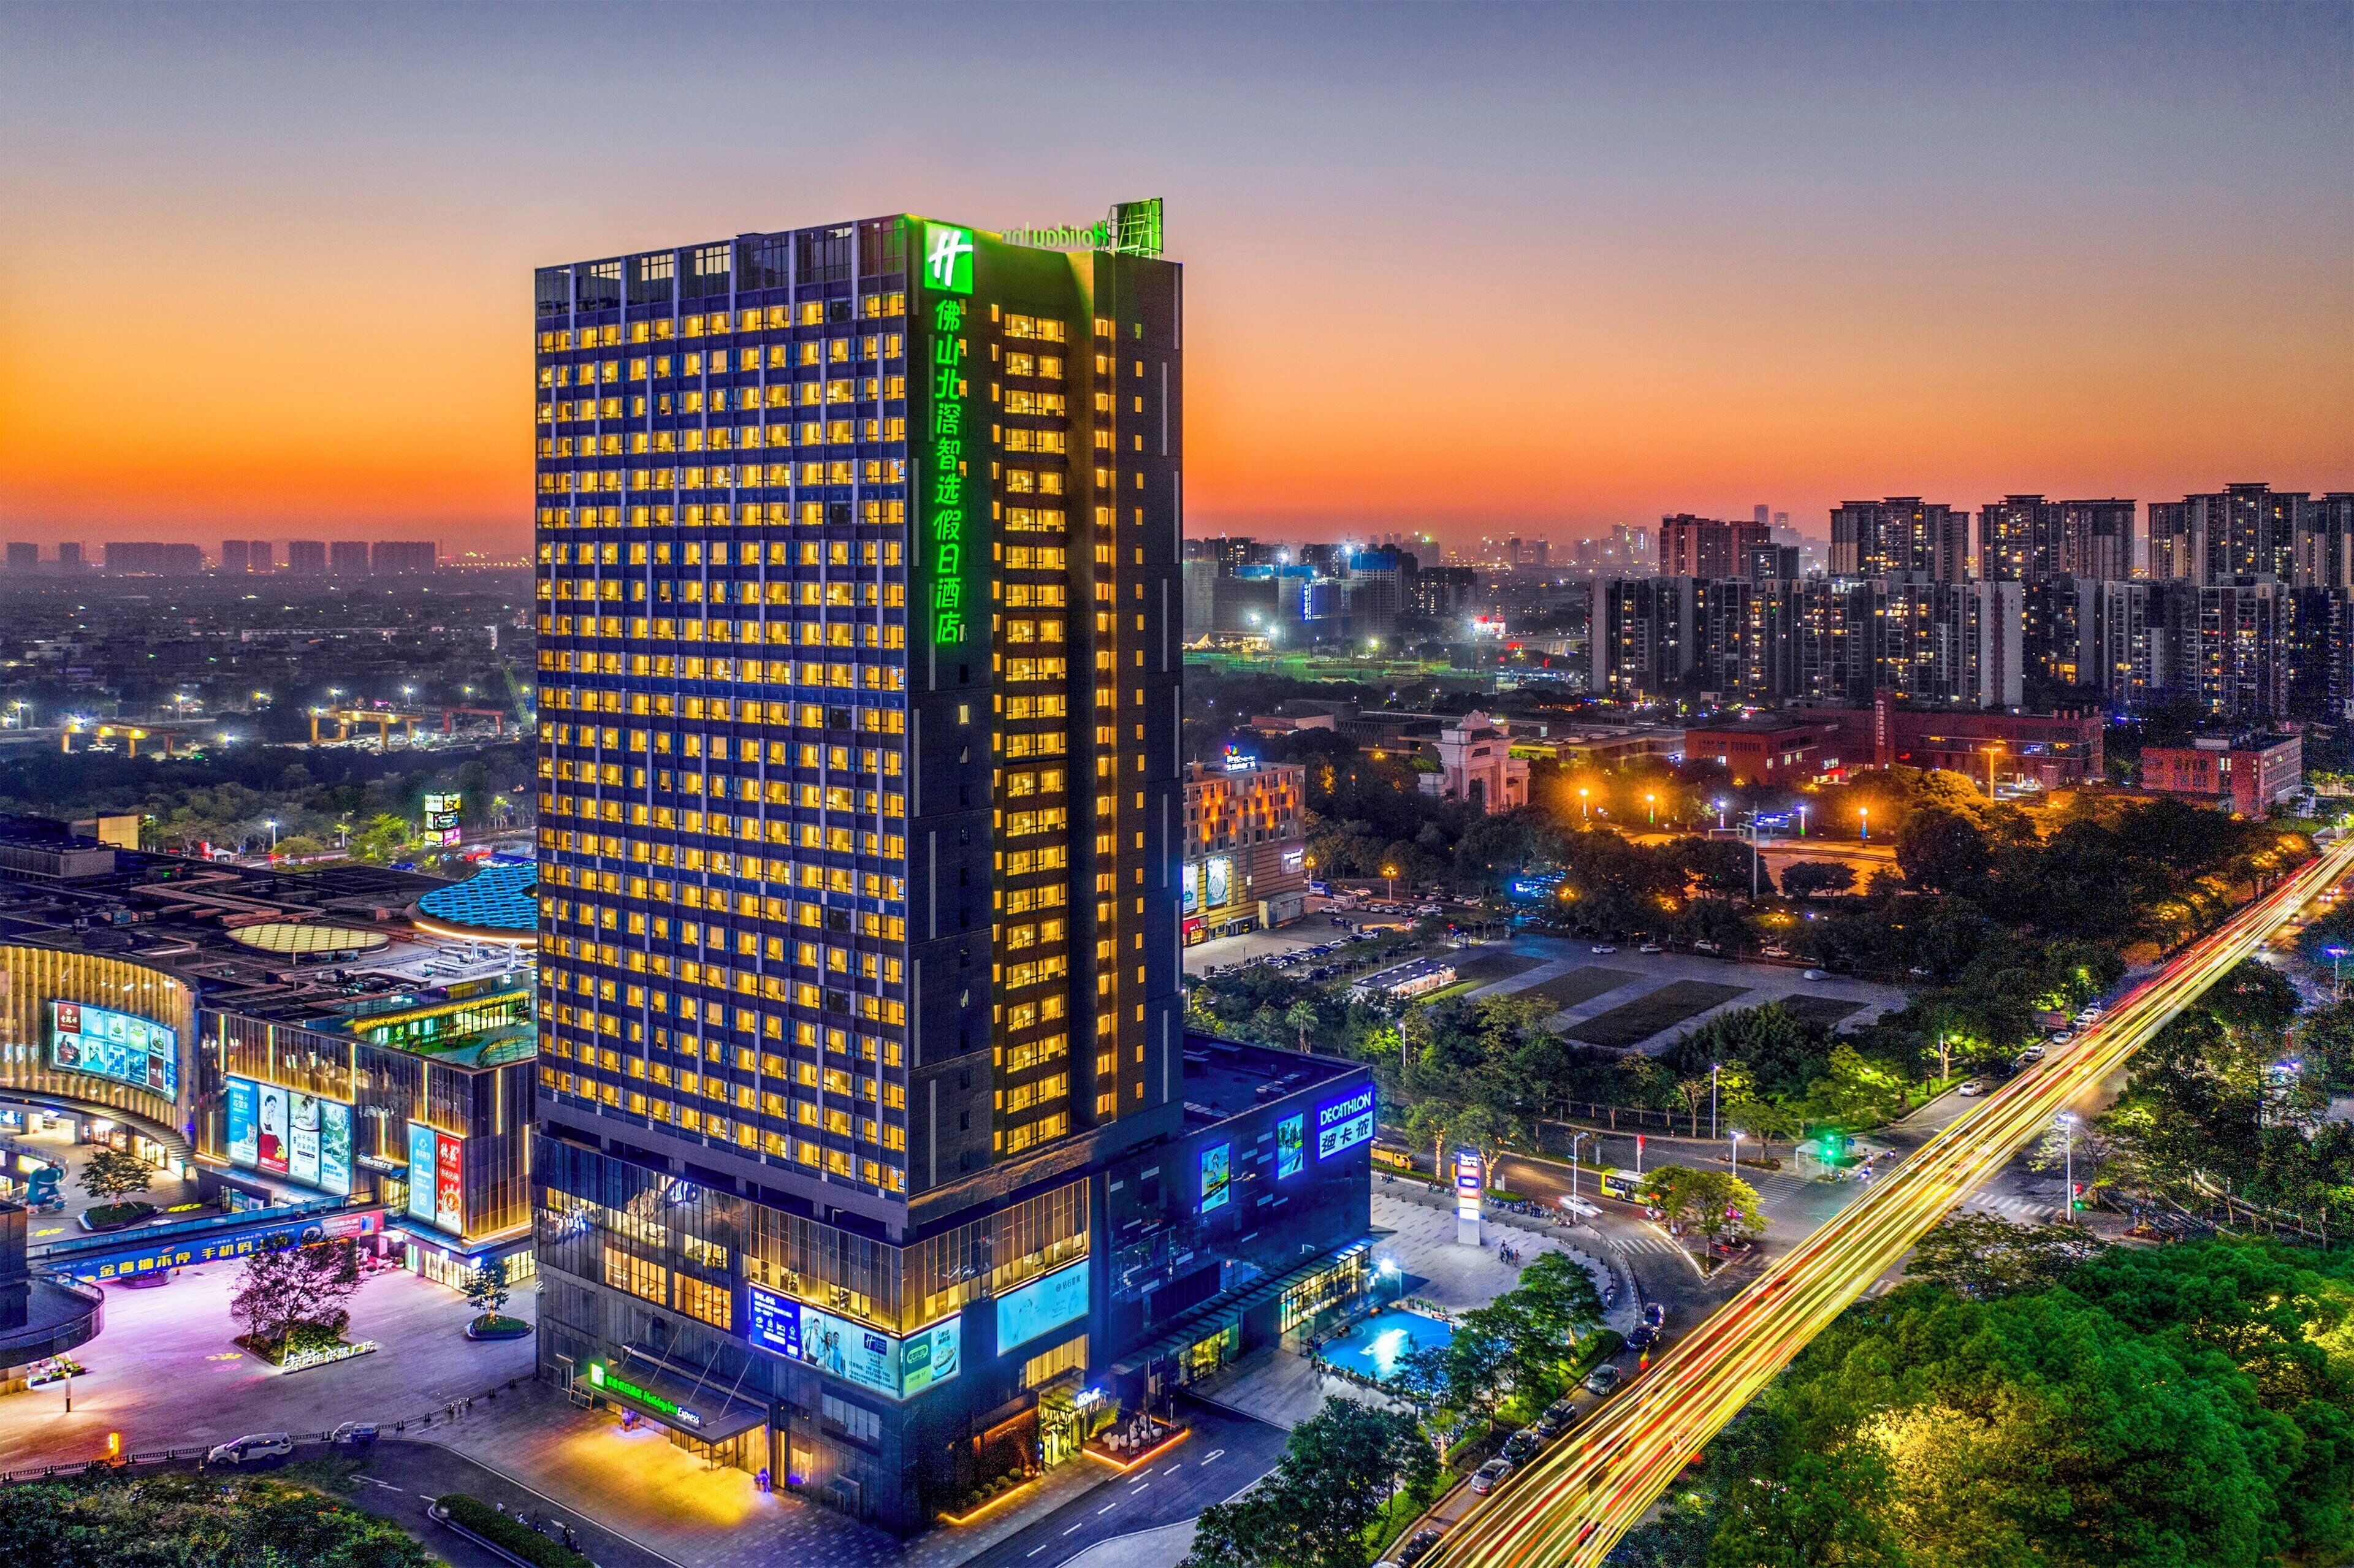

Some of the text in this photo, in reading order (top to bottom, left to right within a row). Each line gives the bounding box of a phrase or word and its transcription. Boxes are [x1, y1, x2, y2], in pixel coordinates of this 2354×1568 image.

[934, 300, 961, 643] 佛山北滘智选假日酒店
[1320, 1091, 1371, 1126] DECATHLON
[1321, 1118, 1370, 1154] 迪卡侬
[644, 1390, 668, 1412] Holiday
[677, 1407, 700, 1424] Express
